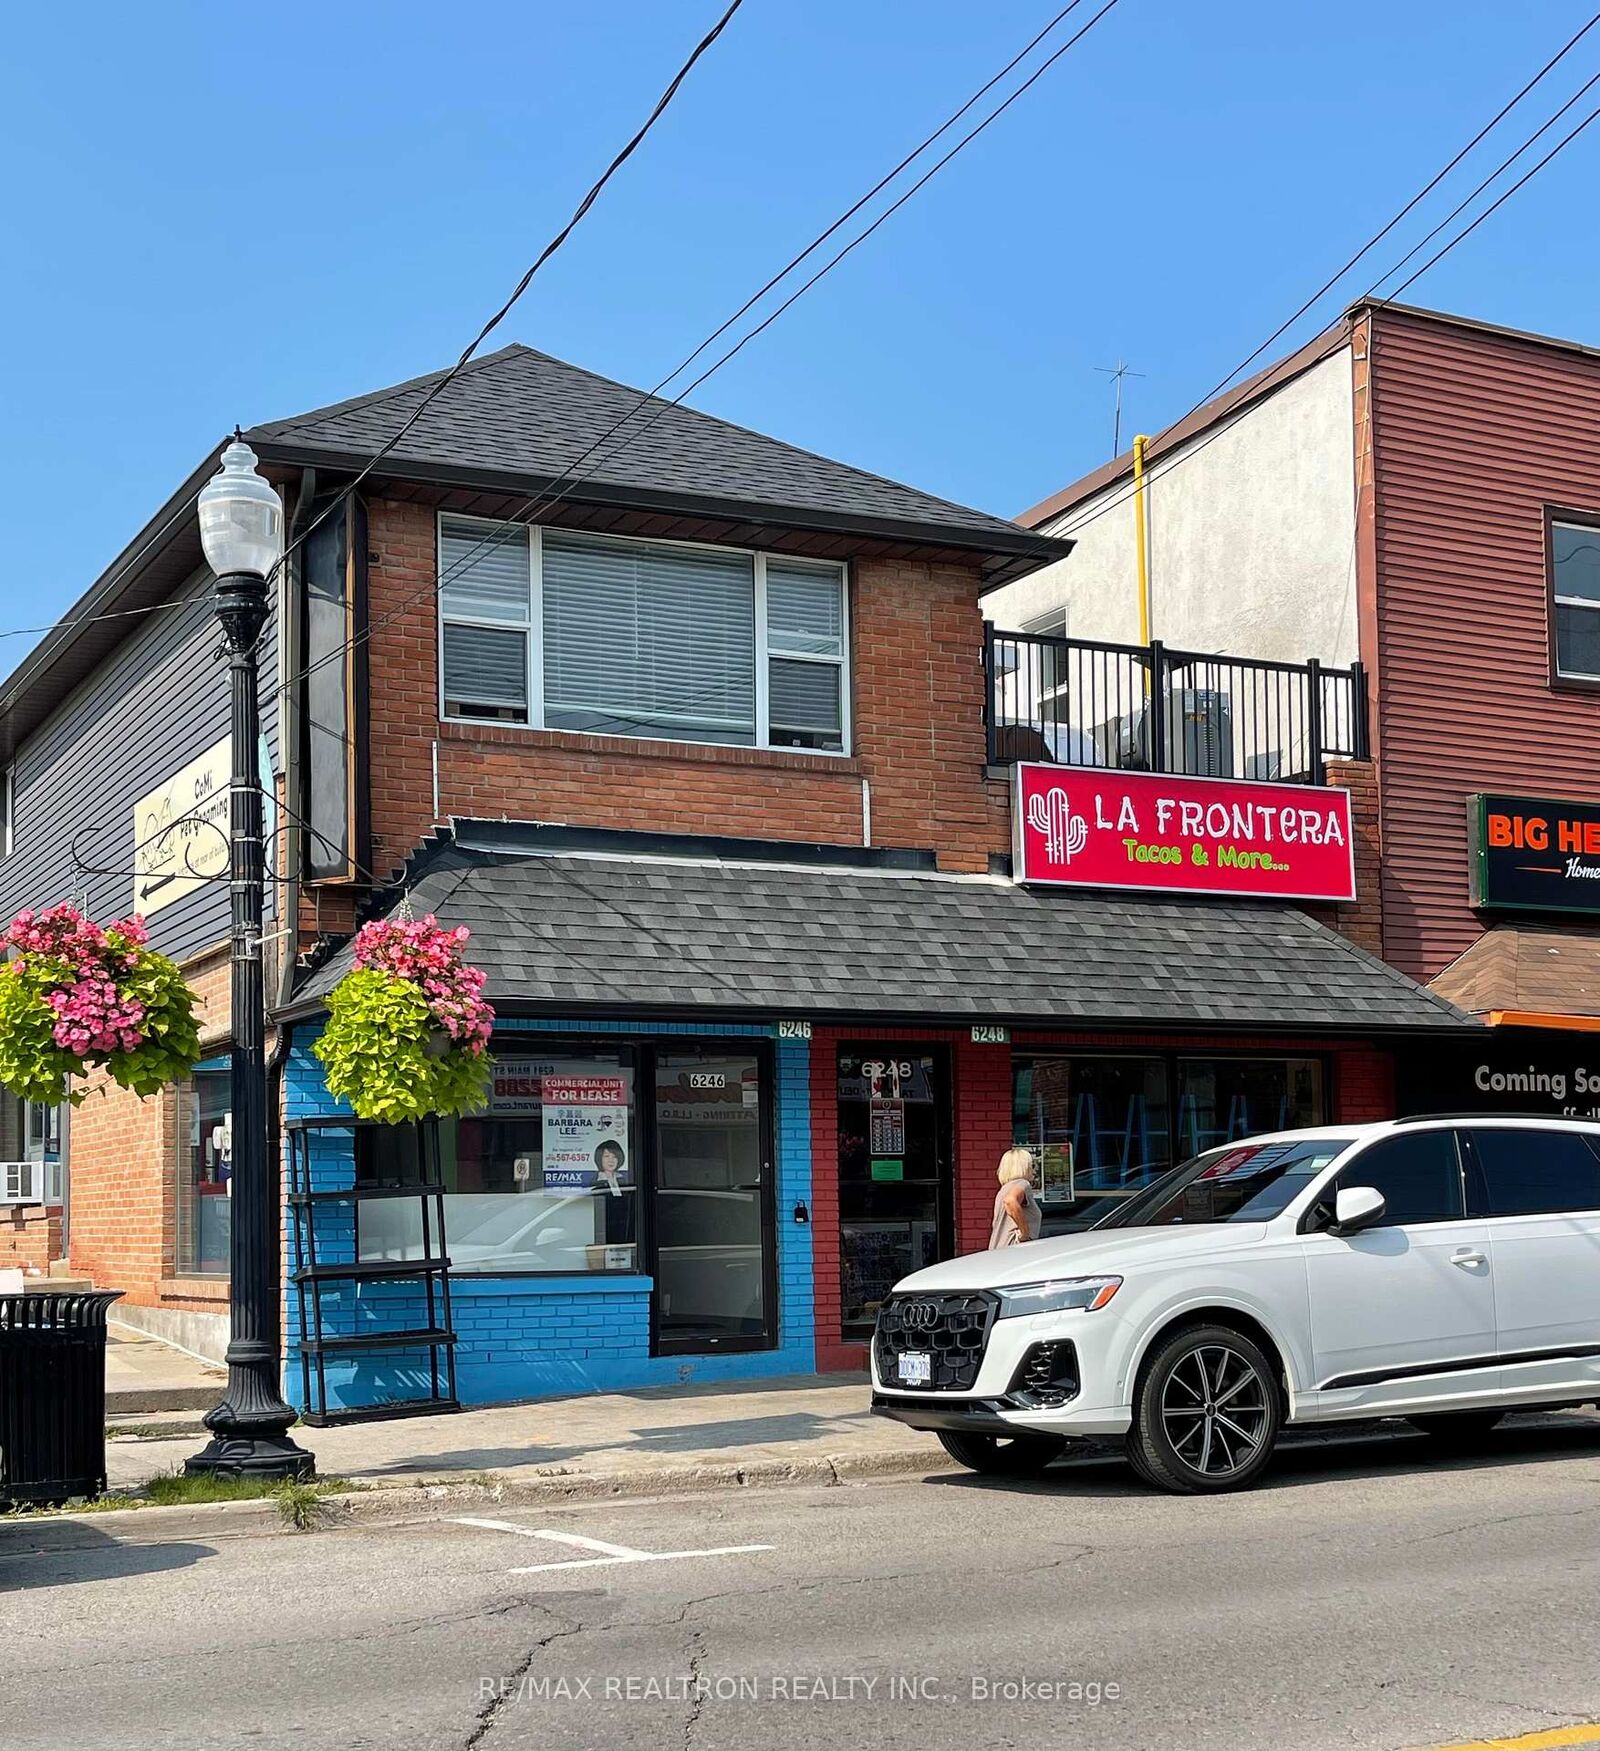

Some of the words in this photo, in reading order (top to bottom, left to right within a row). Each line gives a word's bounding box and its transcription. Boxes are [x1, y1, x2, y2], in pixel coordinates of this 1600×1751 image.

[194, 770, 213, 800] CoMi
[180, 816, 192, 840] Pet
[193, 796, 228, 837] Grooming
[1094, 794, 1139, 834] LA
[1488, 814, 1549, 851] BIG
[1123, 838, 1182, 866] Tacos
[1192, 843, 1209, 867] &
[1218, 845, 1290, 872] More...
[778, 1021, 811, 1038] 6246
[971, 1026, 1005, 1042] 6248
[861, 1061, 912, 1079] 6248
[545, 1079, 602, 1088] COMMERCIAL
[603, 1080, 625, 1088] UNIT
[691, 1074, 725, 1088] 6246
[1475, 1065, 1566, 1100] Coming
[1574, 1067, 1600, 1093] So
[552, 1090, 577, 1100] FOR
[580, 1090, 618, 1101] LEASE
[548, 1118, 593, 1127] BARBARA
[559, 1128, 577, 1136] LEE
[545, 1173, 583, 1182] RE/MAX
